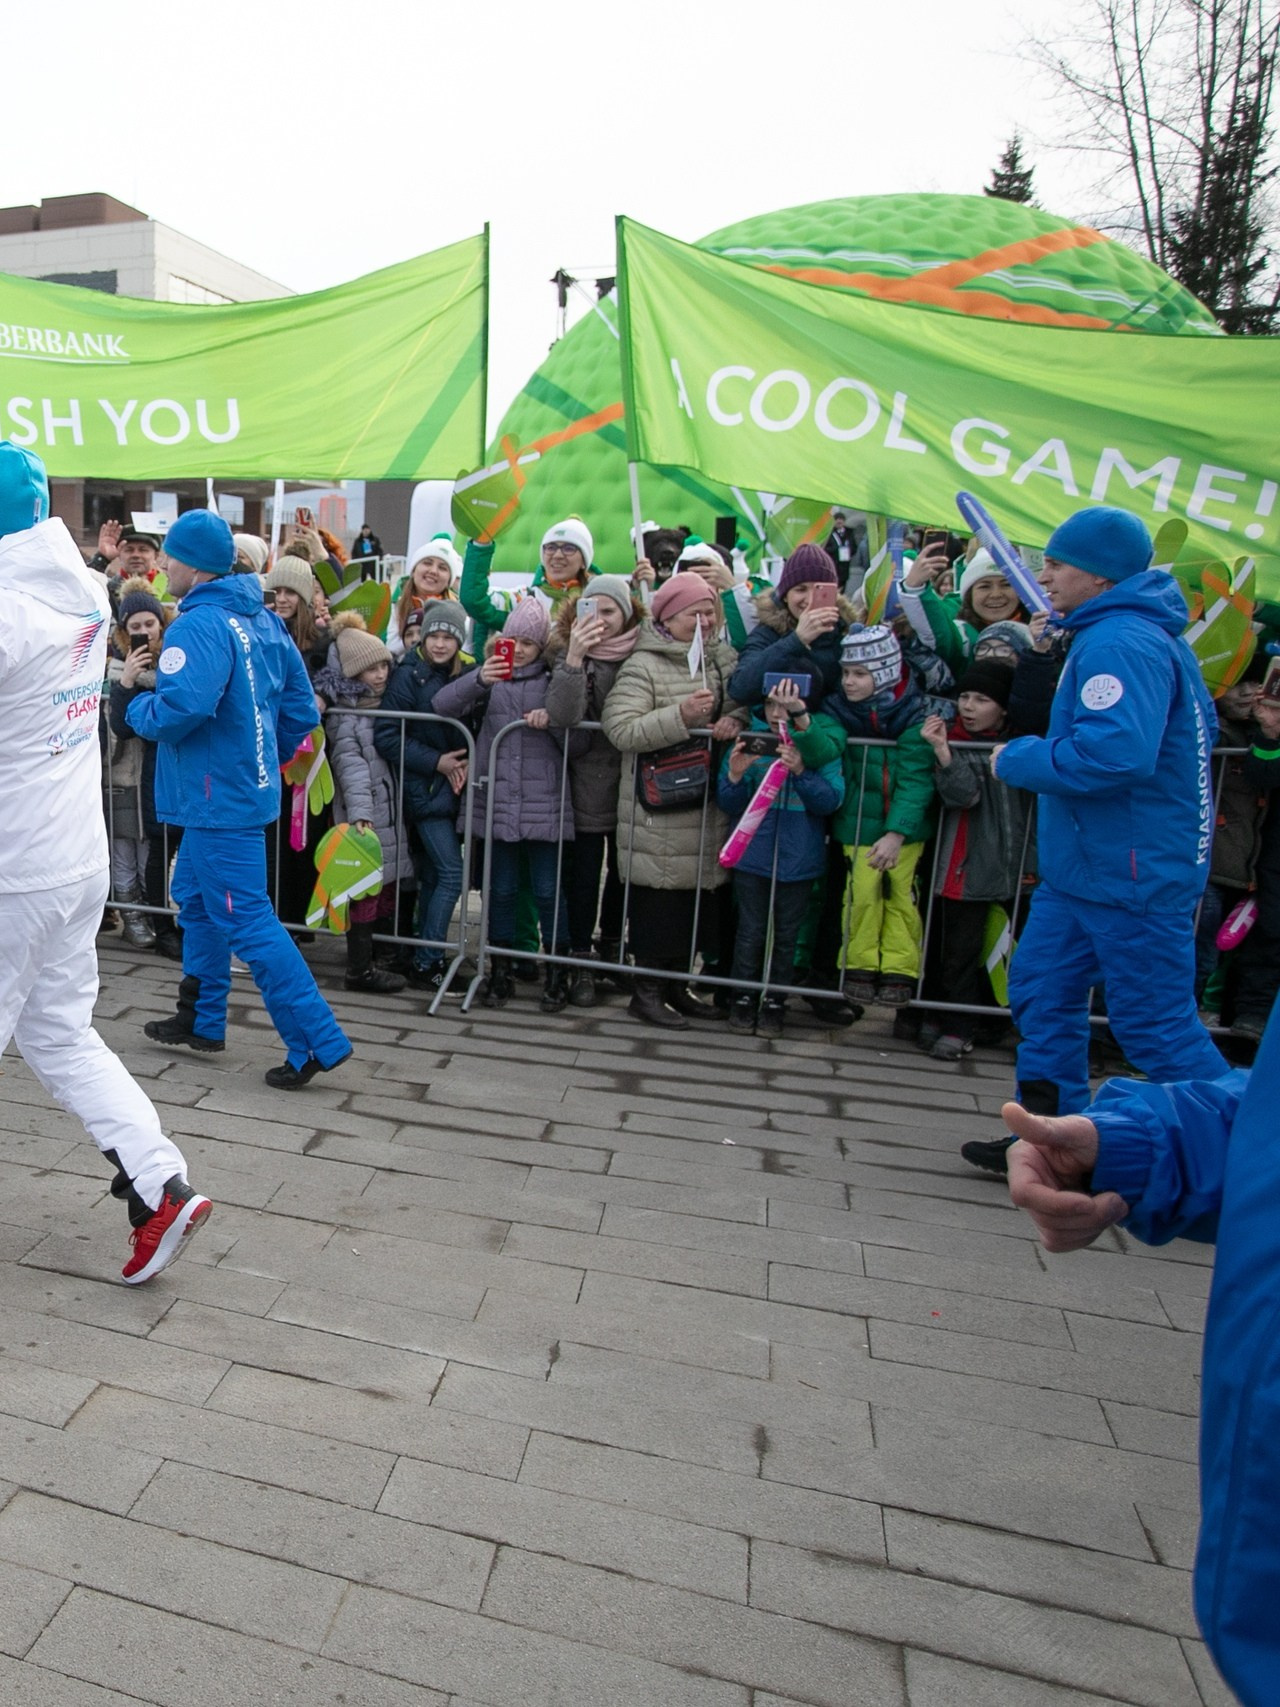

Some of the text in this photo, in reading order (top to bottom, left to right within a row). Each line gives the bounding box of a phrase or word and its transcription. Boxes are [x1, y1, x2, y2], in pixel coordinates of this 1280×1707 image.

[97, 398, 241, 446] YOU
[706, 365, 927, 454] COOL
[950, 417, 1279, 540] GAME!
